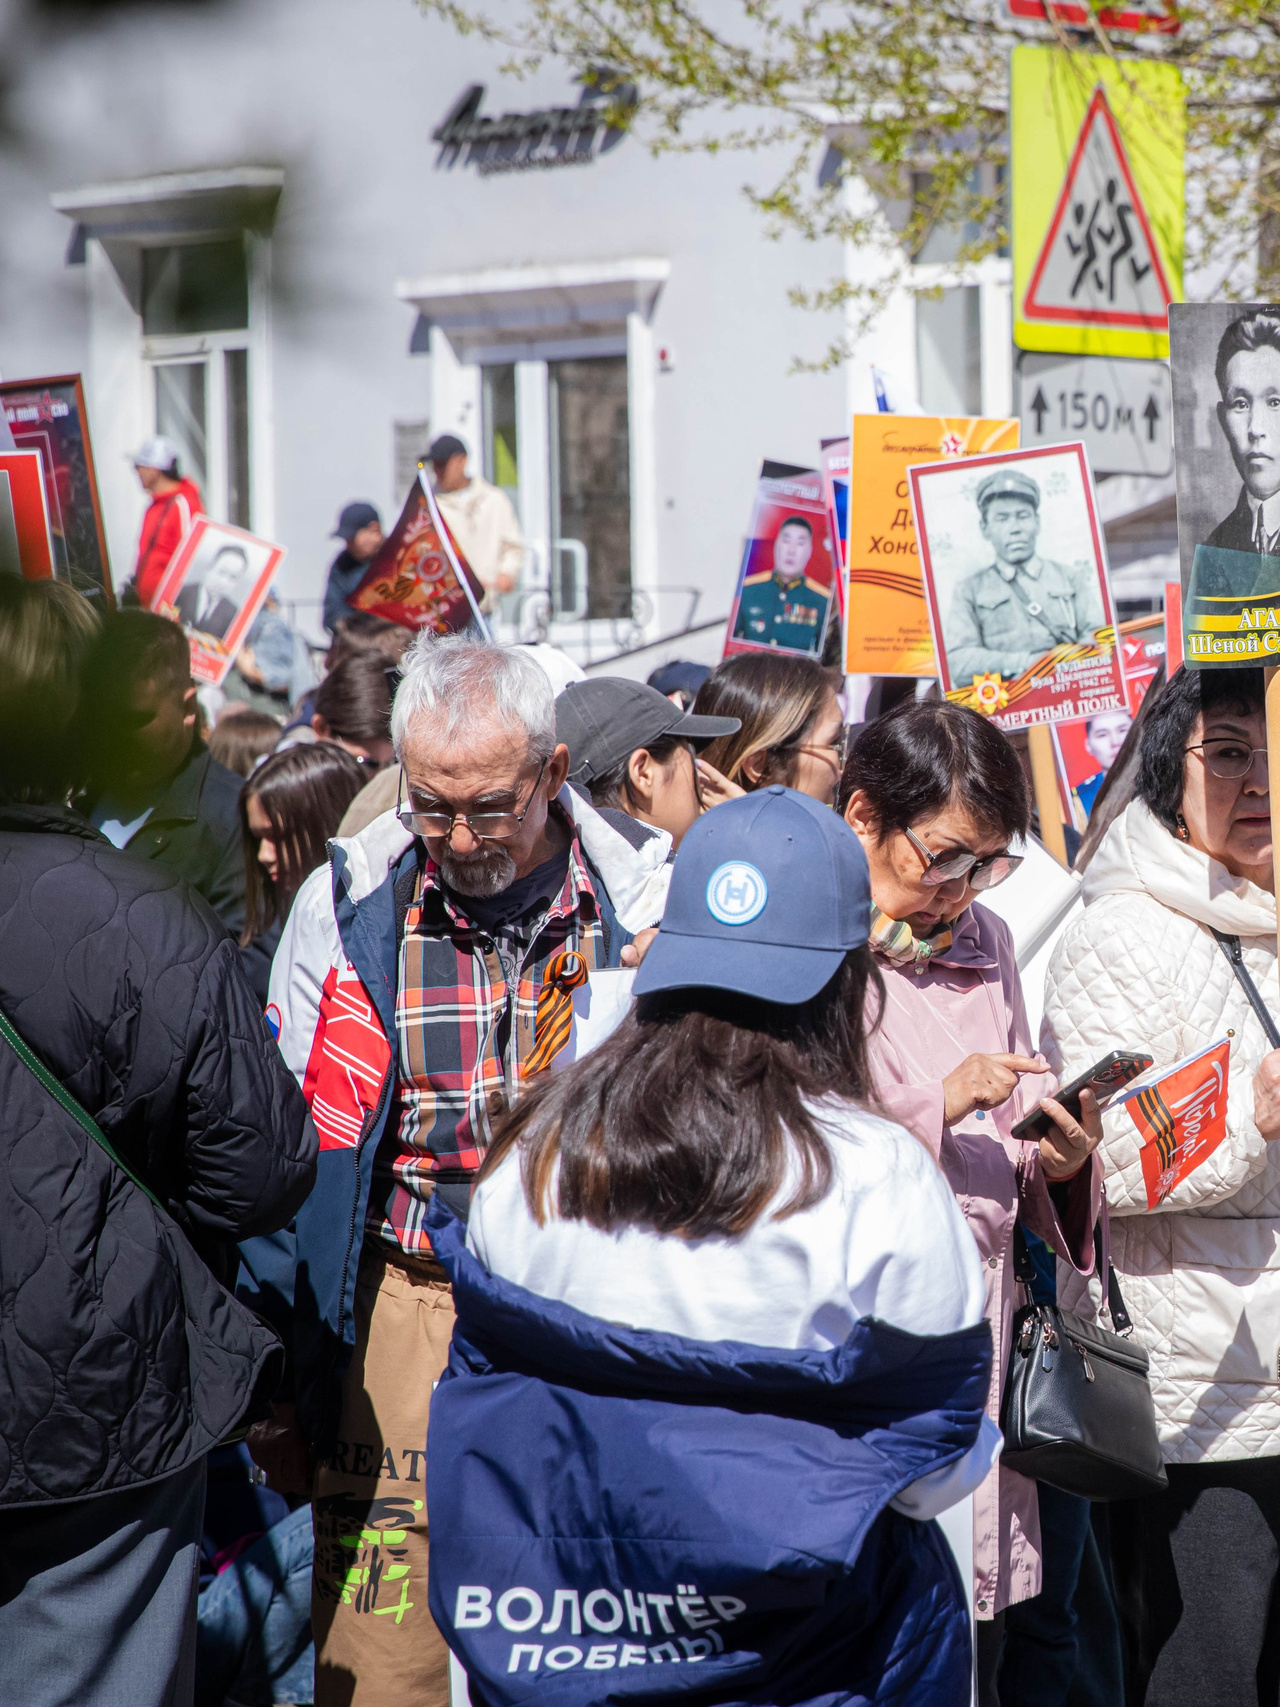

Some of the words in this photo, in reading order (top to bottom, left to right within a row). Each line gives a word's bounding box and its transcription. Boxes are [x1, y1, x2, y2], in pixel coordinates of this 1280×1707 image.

[1190, 634, 1259, 654] Шеной
[1078, 694, 1122, 714] ПОЛК
[454, 1584, 747, 1635] ВОЛОНТЁР
